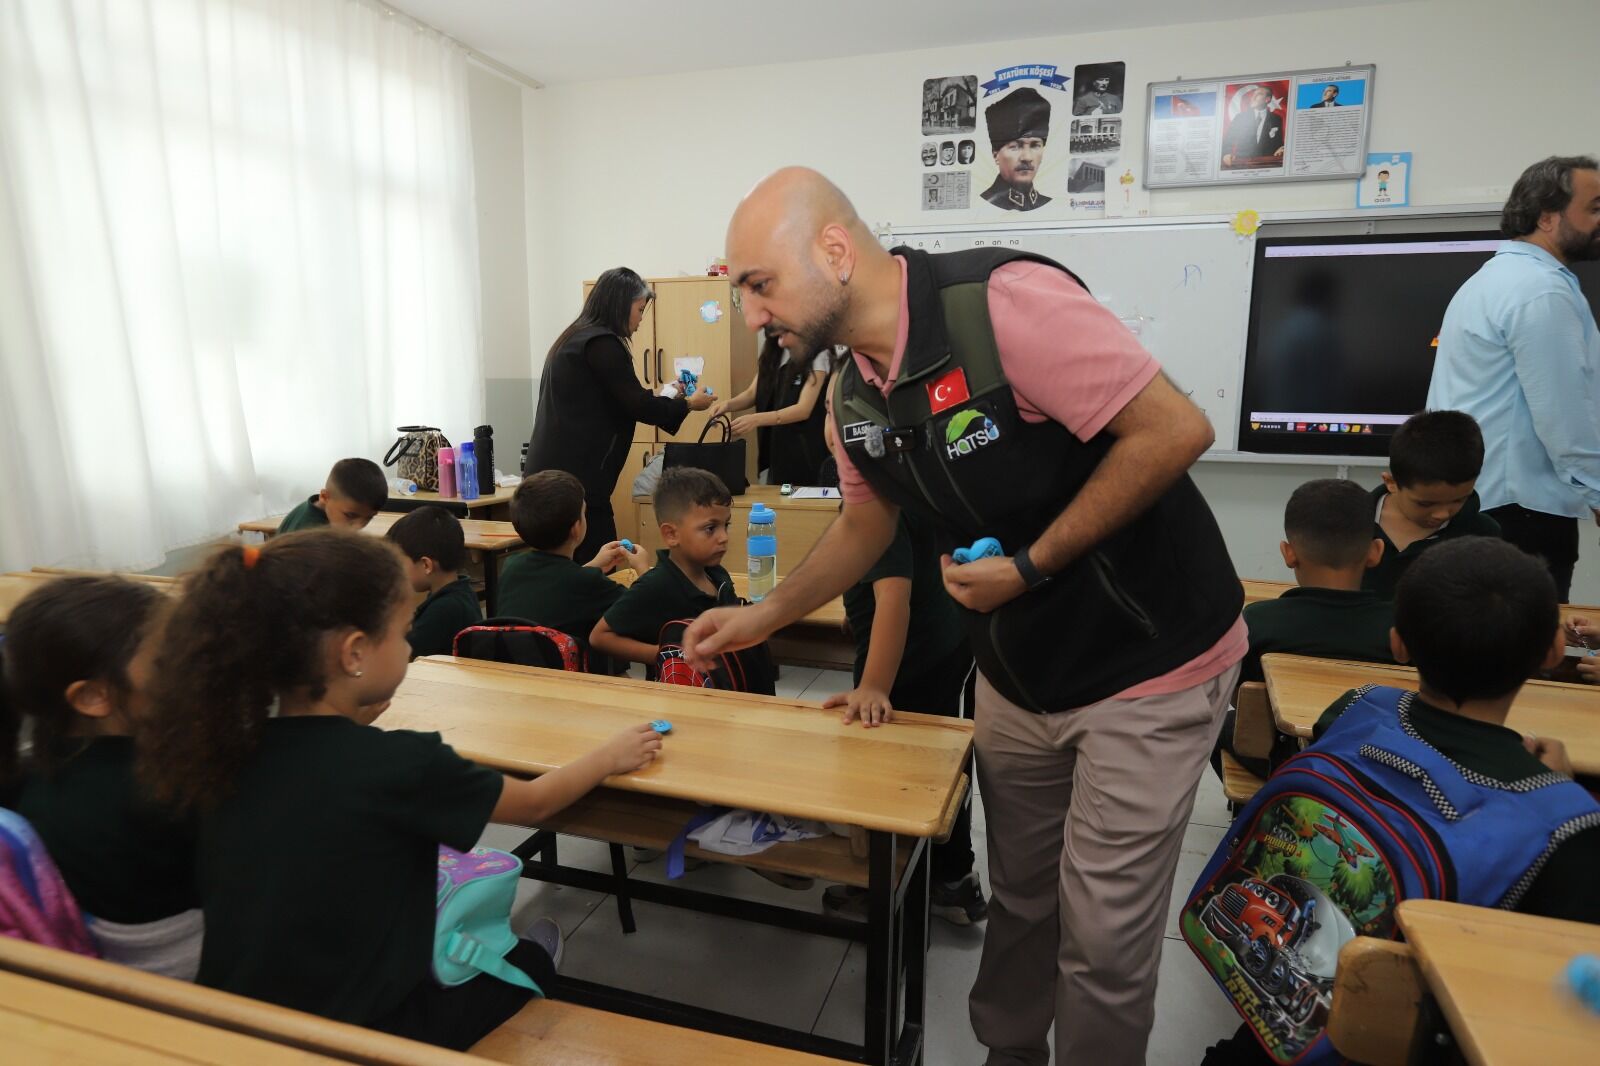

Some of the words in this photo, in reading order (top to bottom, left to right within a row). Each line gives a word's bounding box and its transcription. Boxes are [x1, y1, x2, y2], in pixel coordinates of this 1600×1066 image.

[998, 67, 1029, 81] ATATÜRK
[1029, 65, 1055, 78] KÖŞESİ
[933, 239, 941, 248] A
